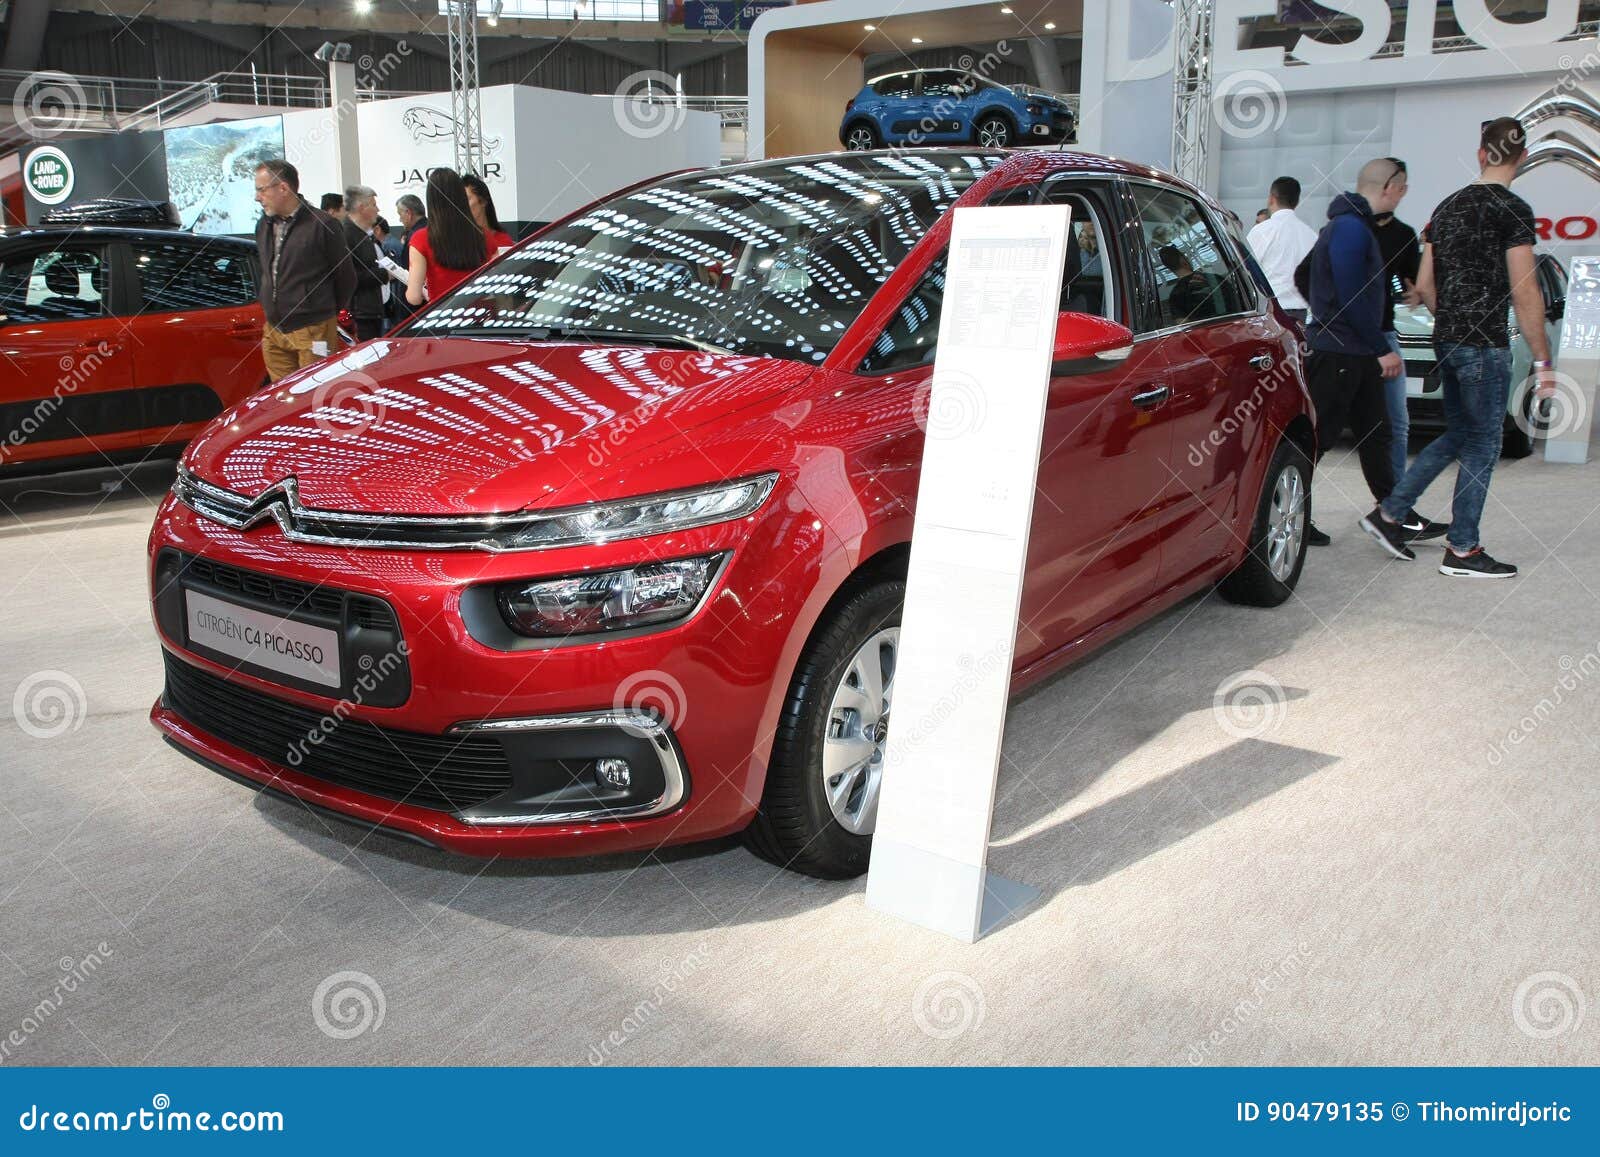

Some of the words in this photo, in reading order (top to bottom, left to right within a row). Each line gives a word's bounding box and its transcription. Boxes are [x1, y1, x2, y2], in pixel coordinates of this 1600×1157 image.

[393, 163, 502, 185] JAR
[196, 610, 242, 641] CITROËN
[244, 627, 261, 648] C4
[264, 632, 324, 665] PICASSO
